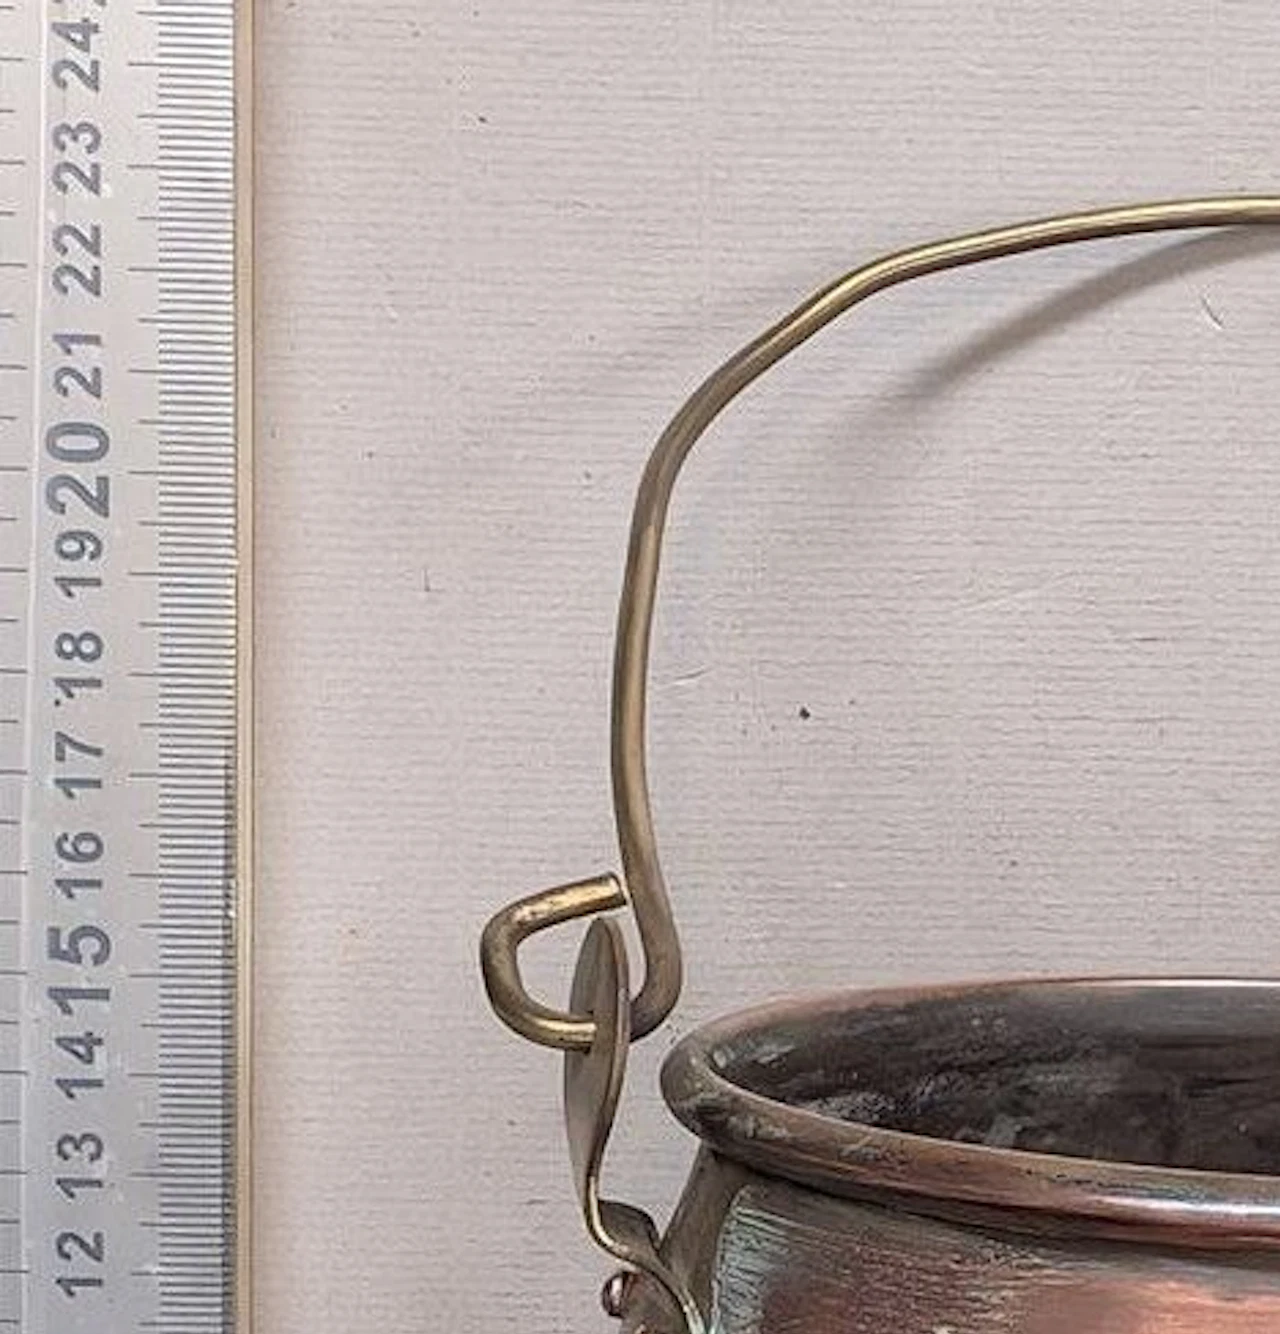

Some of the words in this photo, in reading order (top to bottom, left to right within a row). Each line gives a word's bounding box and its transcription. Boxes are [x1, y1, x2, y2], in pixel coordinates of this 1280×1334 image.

[51, 18, 100, 93] 24
[51, 122, 102, 196] 23
[52, 224, 101, 297] 22
[53, 334, 102, 400] 21
[45, 422, 109, 518] 20
[54, 530, 103, 598] 19
[54, 632, 104, 699] 18
[54, 731, 103, 800] 17
[54, 832, 103, 899] 16
[47, 925, 111, 1016] 15
[55, 1031, 104, 1100] 14
[56, 1133, 103, 1199] 13
[55, 1232, 104, 1297] 12
